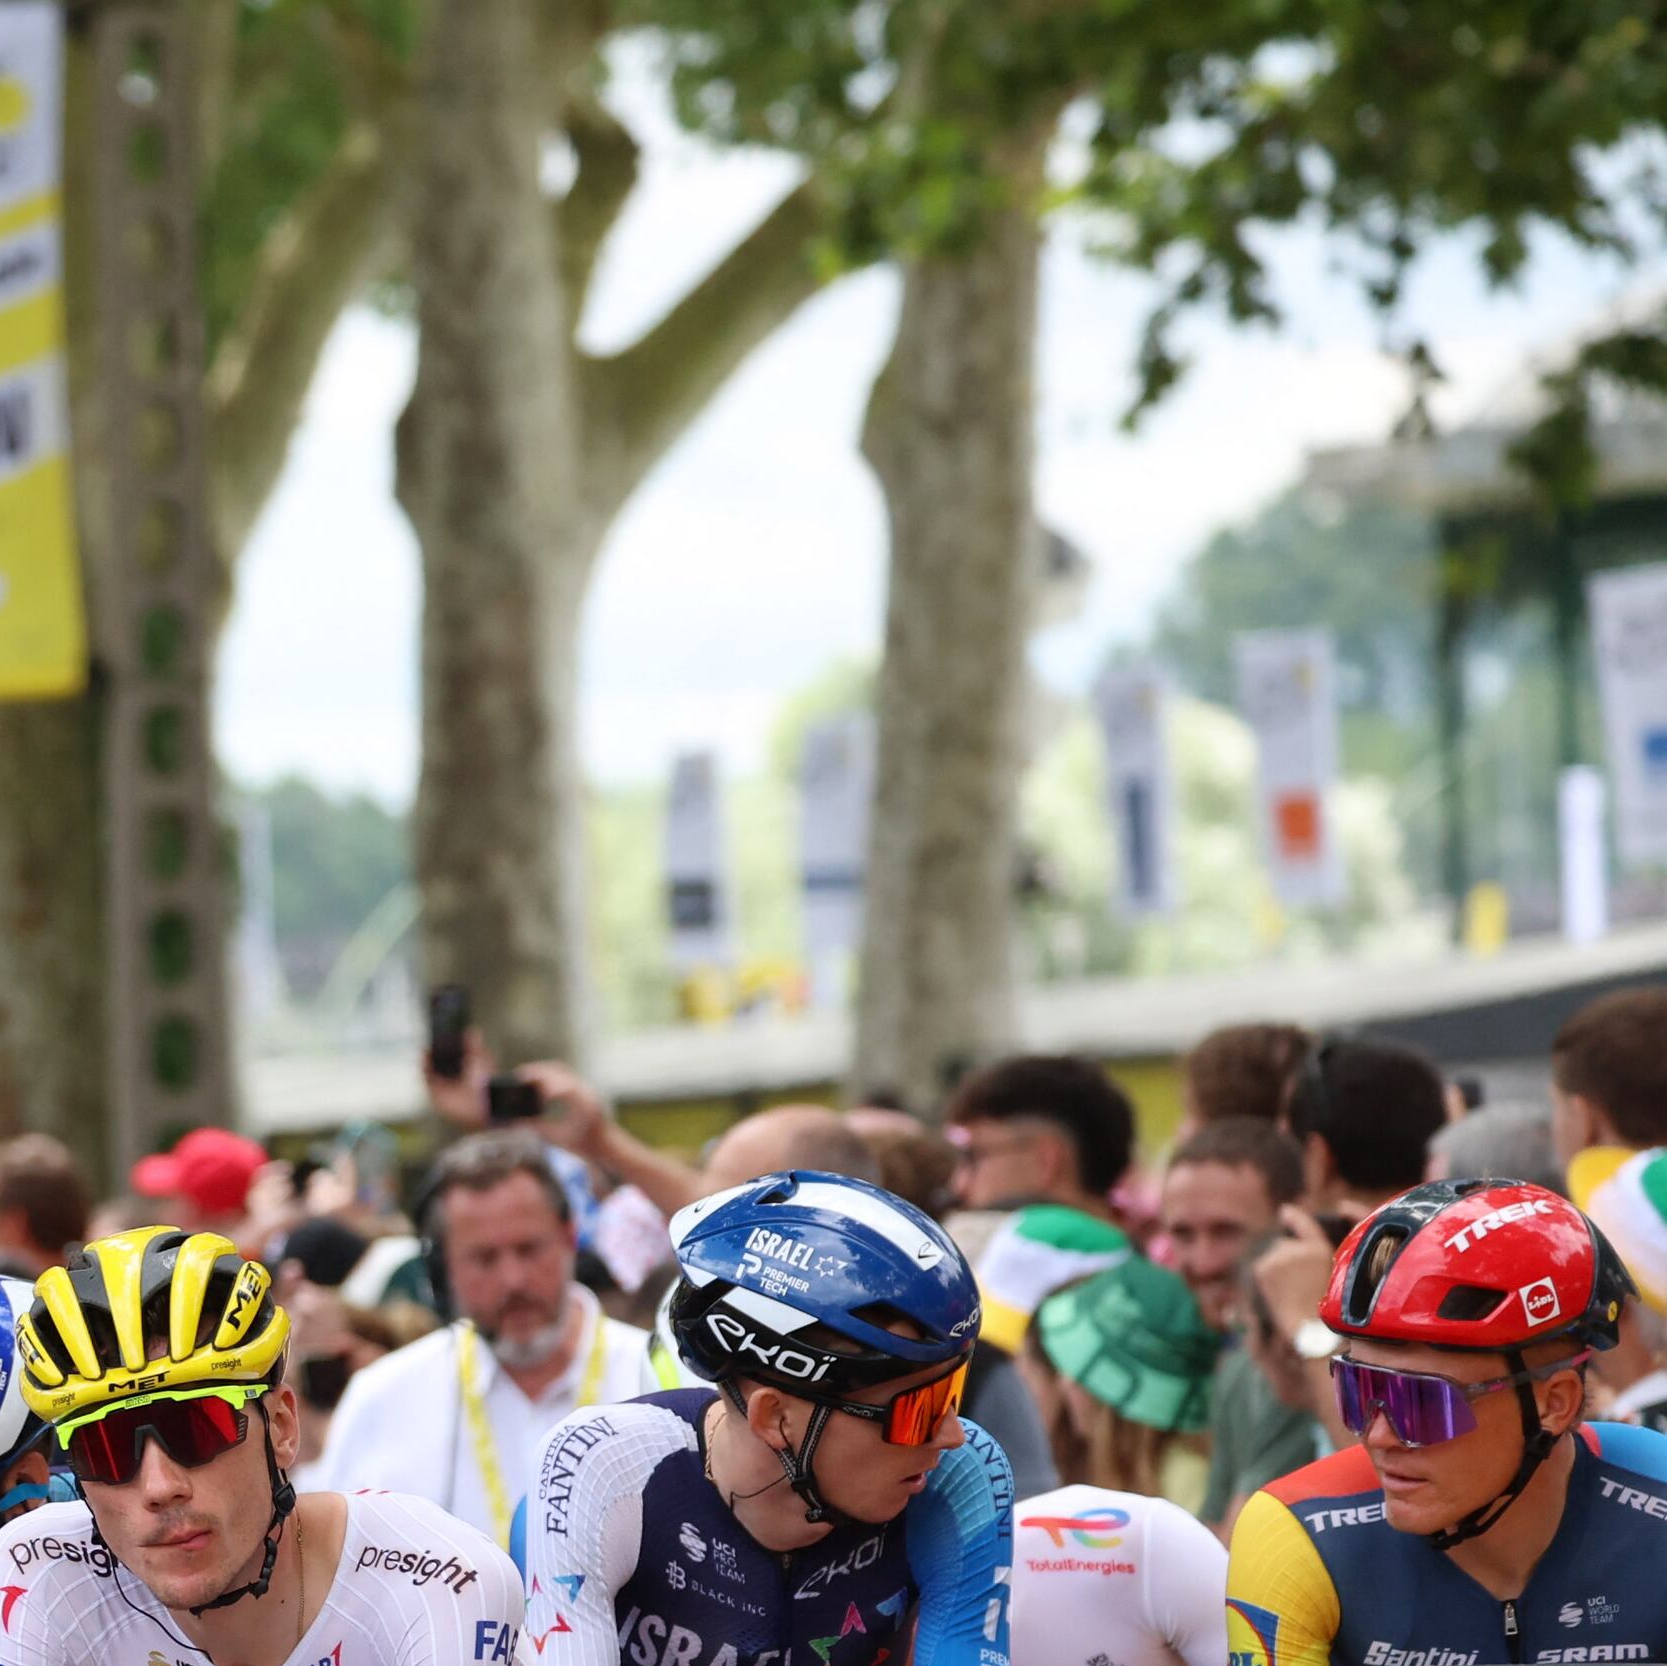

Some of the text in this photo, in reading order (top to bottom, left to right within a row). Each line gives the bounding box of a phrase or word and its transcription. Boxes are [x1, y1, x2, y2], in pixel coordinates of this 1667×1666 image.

[1444, 1198, 1553, 1254] TREK
[744, 1226, 813, 1272] ISRAEL
[759, 1279, 788, 1297] TECH
[762, 1266, 810, 1293] PREMIER
[225, 1260, 266, 1331] MET
[107, 1370, 170, 1393] MET
[538, 1423, 576, 1502] CANTINA
[546, 1415, 621, 1537] FANTINI
[712, 1537, 737, 1558] UCI
[713, 1549, 738, 1569] PRO
[354, 1544, 480, 1595] presight
[714, 1563, 746, 1586] TEAM
[1025, 1556, 1136, 1577] TotalEnergies
[690, 1580, 767, 1618] BLACK INC
[1587, 1597, 1606, 1608] UCI
[1588, 1604, 1620, 1618] WORLD
[1588, 1613, 1614, 1626] TEAM
[1536, 1642, 1650, 1664] SRAM
